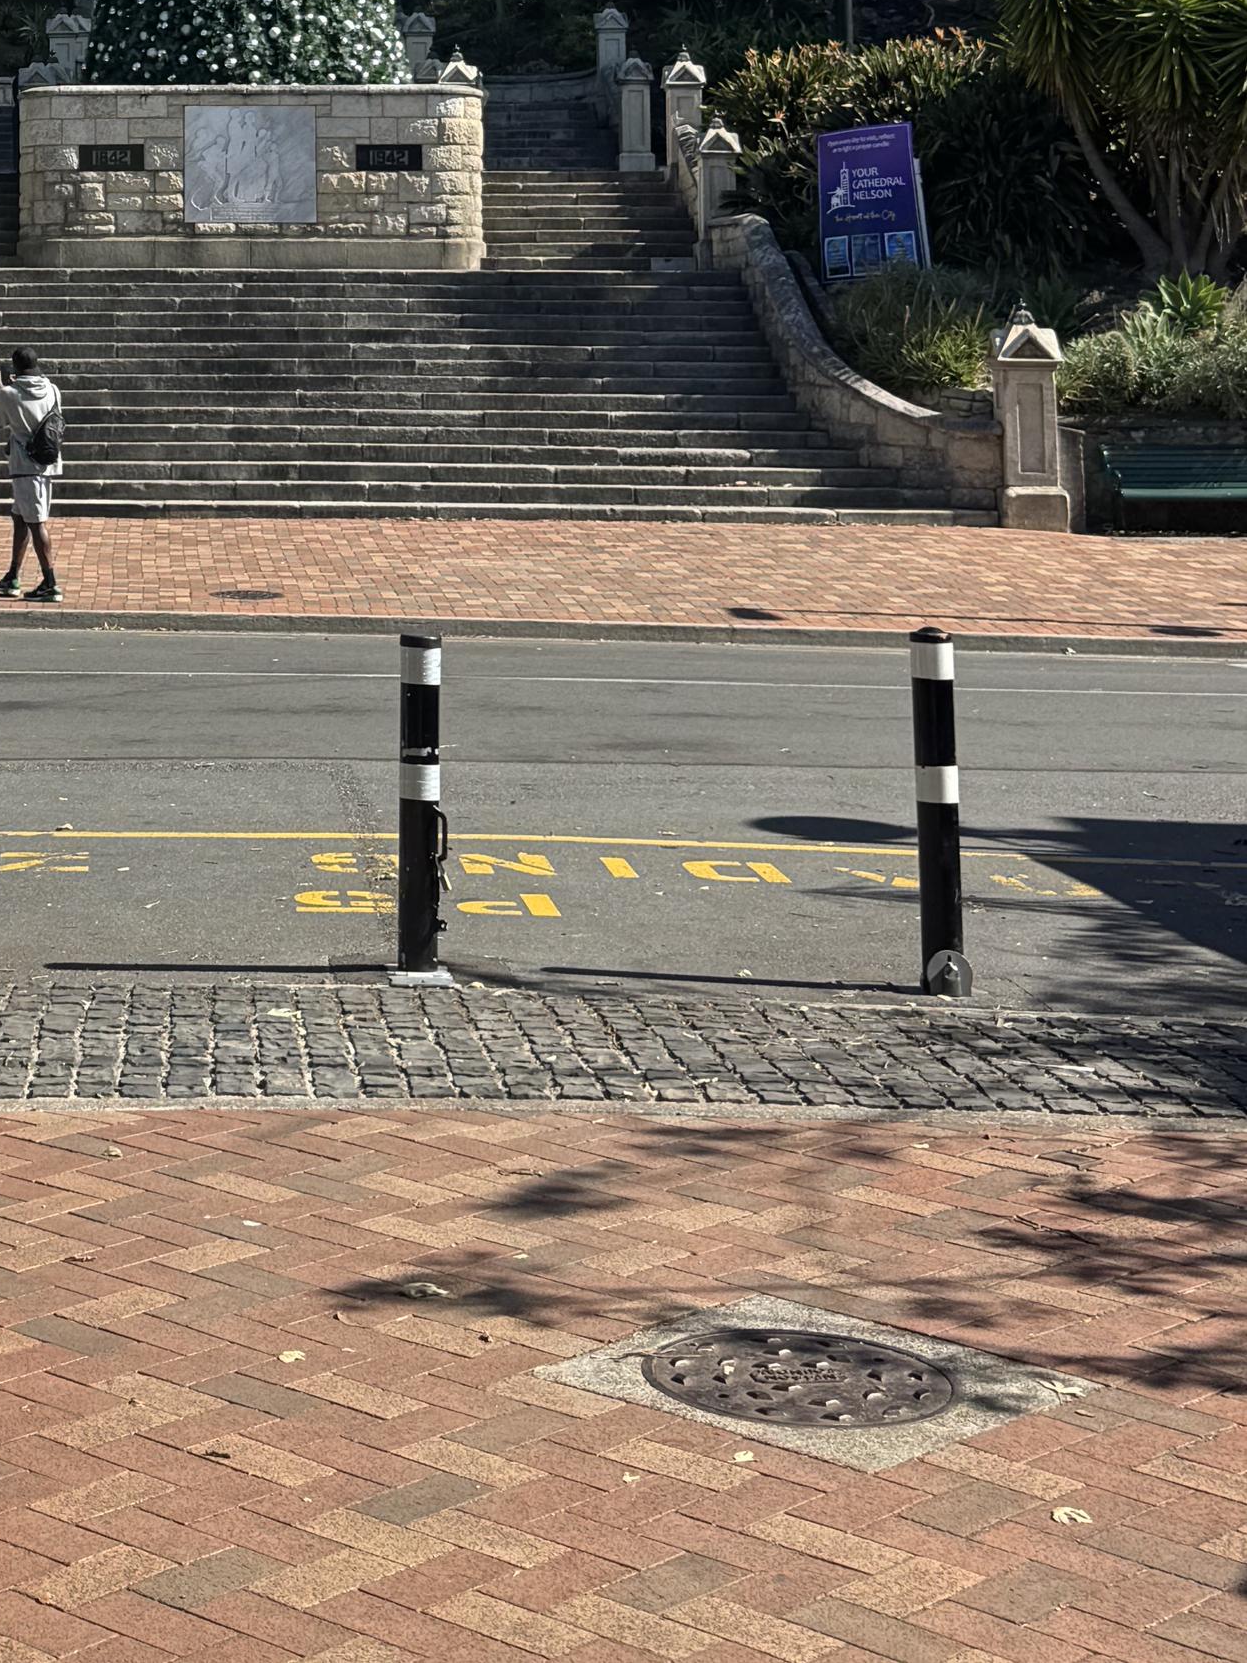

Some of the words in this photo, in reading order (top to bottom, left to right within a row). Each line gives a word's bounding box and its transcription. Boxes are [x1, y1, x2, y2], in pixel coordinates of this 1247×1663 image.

[852, 167, 878, 178] YOUR
[852, 177, 905, 189] CATHEDRAL
[853, 189, 892, 200] NELSON
